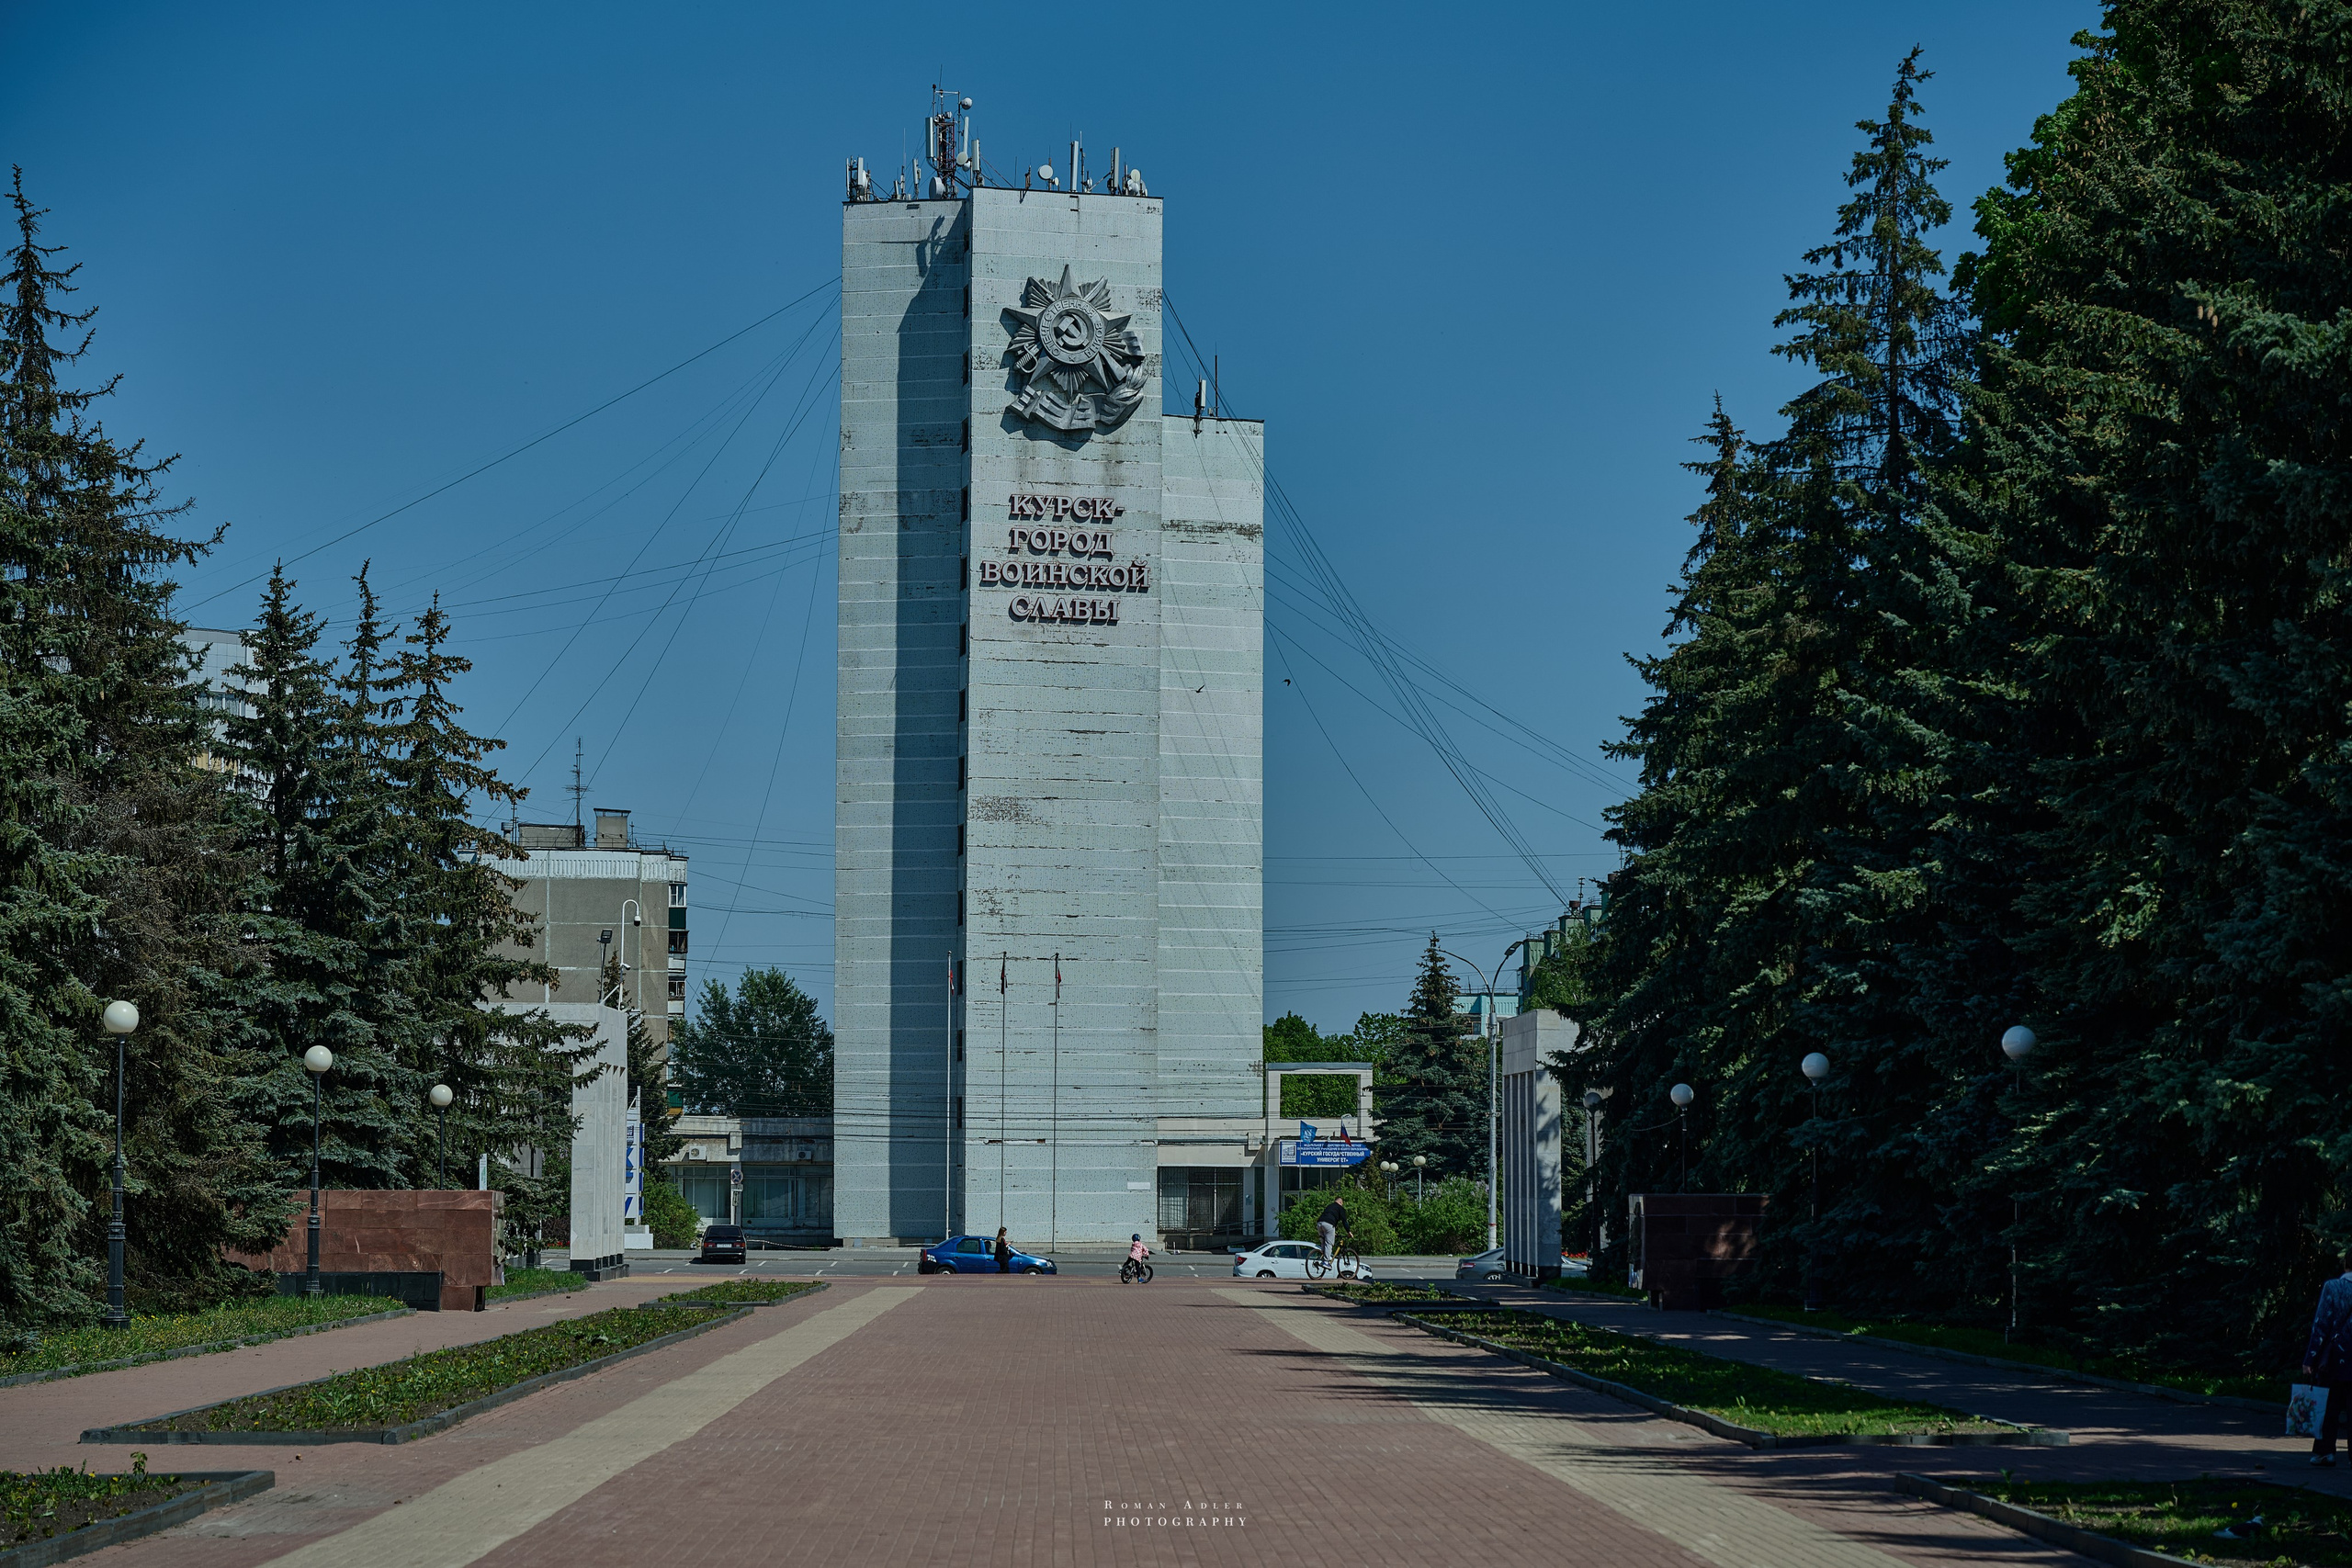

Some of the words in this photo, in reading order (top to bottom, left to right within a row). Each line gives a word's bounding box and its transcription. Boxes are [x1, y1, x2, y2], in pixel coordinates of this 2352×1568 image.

[1041, 300, 1094, 356] ОТЕЧЕСТВЕННАЯ
[1010, 494, 1125, 519] КУРСК-
[1010, 528, 1114, 556] ГОРОД
[981, 559, 1150, 588] ВОИНСКОЙ
[1010, 595, 1120, 621] СЛАВЫ
